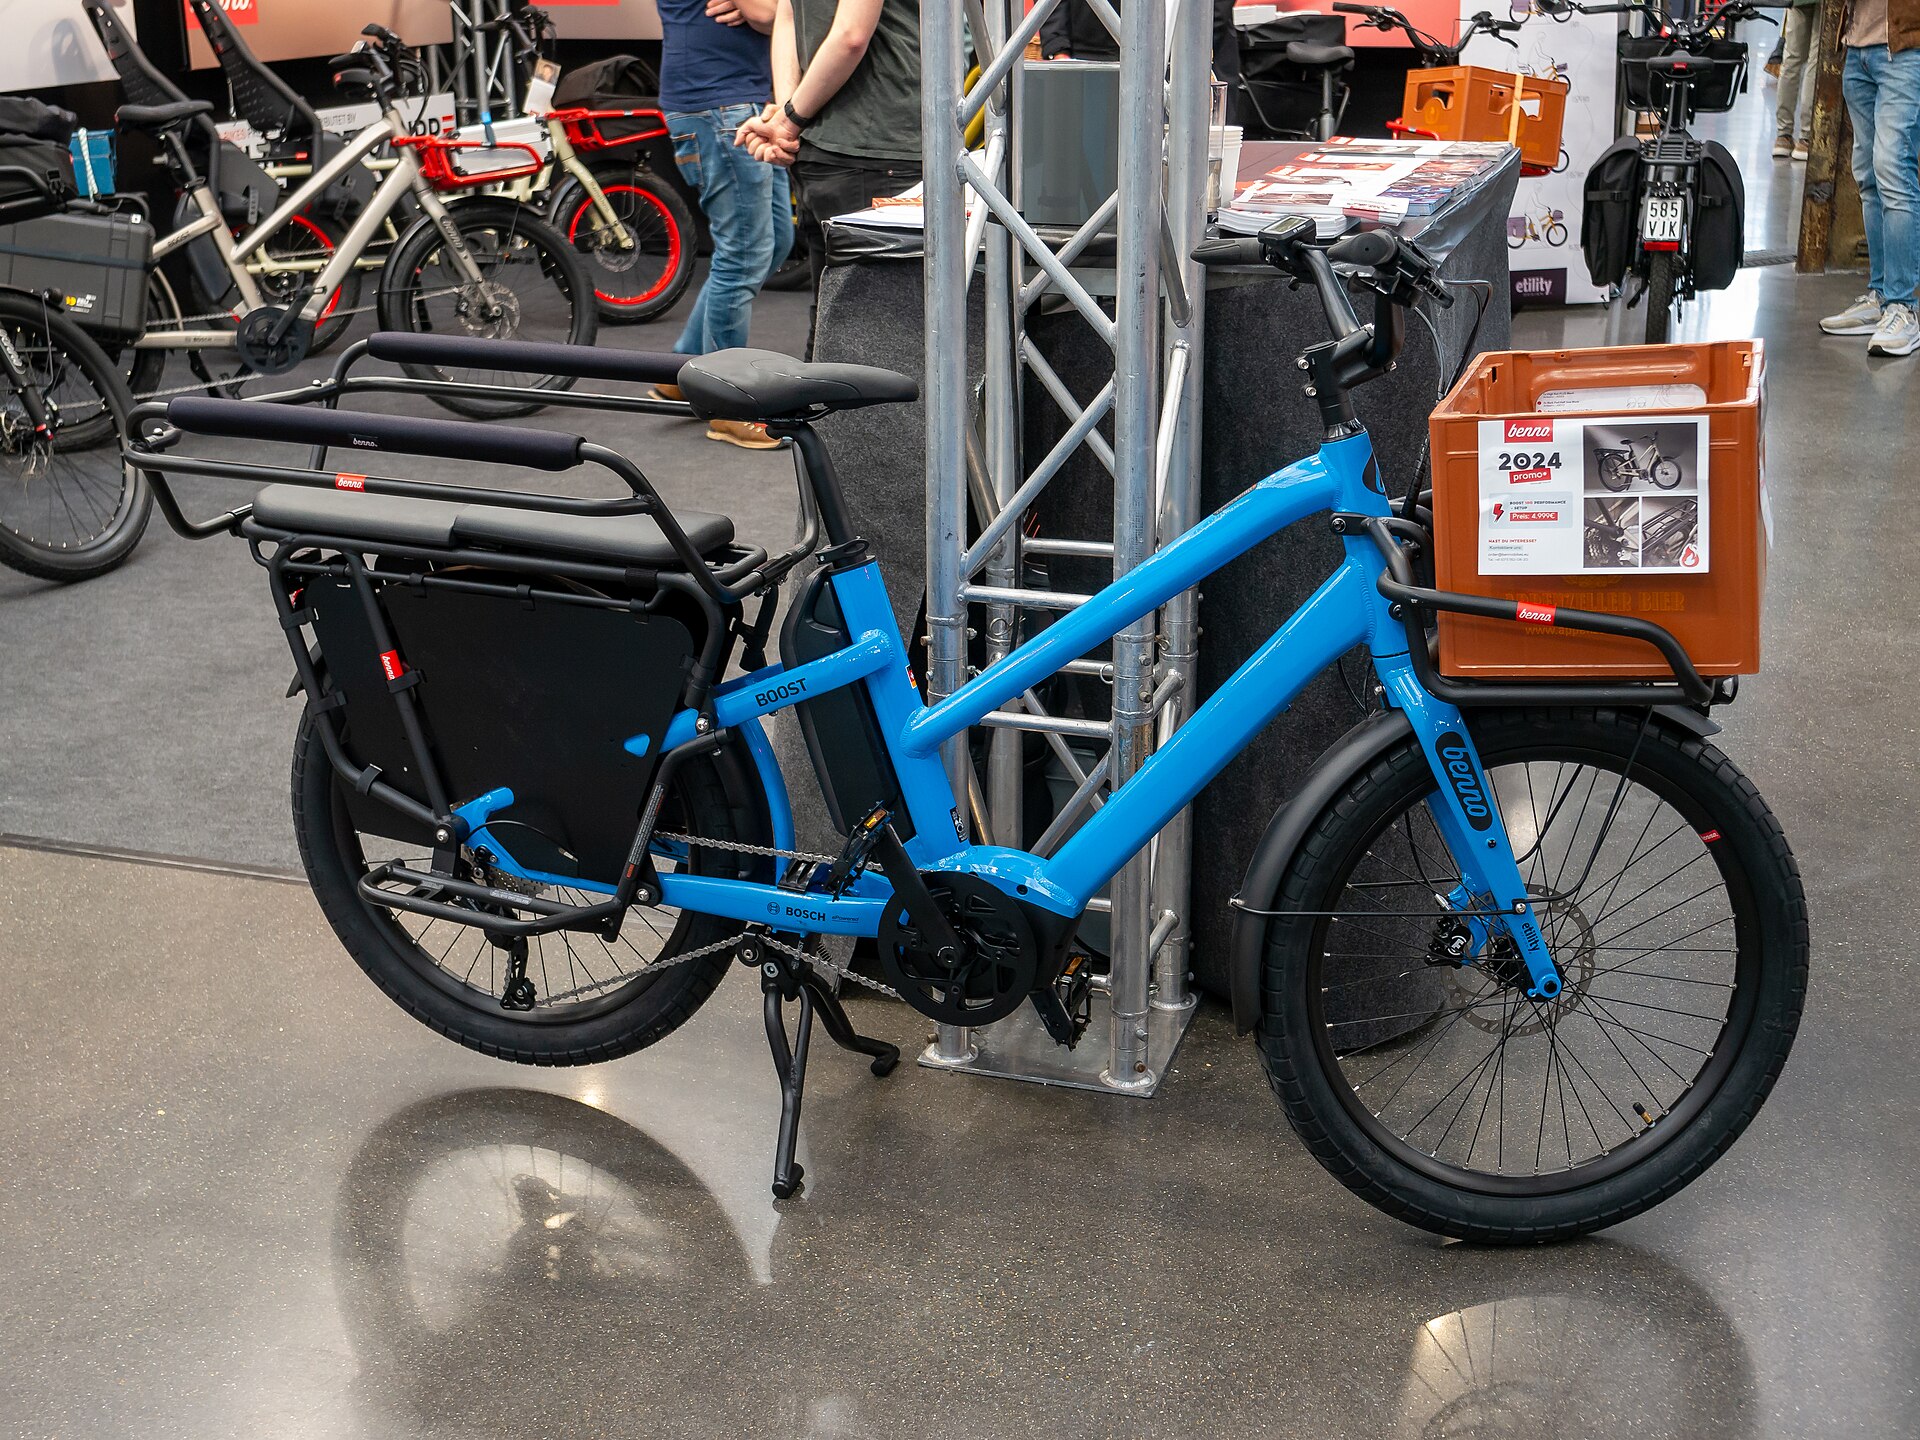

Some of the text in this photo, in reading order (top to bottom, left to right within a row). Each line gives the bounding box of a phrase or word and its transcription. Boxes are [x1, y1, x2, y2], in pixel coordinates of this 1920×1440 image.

[1650, 201, 1678, 218] 585
[1649, 220, 1677, 238] VJK
[1515, 276, 1553, 296] etility
[1498, 452, 1562, 471] 2024
[1638, 592, 1686, 611] BIER
[755, 677, 809, 708] BOOST
[1442, 746, 1488, 818] benno
[785, 906, 827, 923] BOSCH
[1520, 921, 1541, 953] etility
